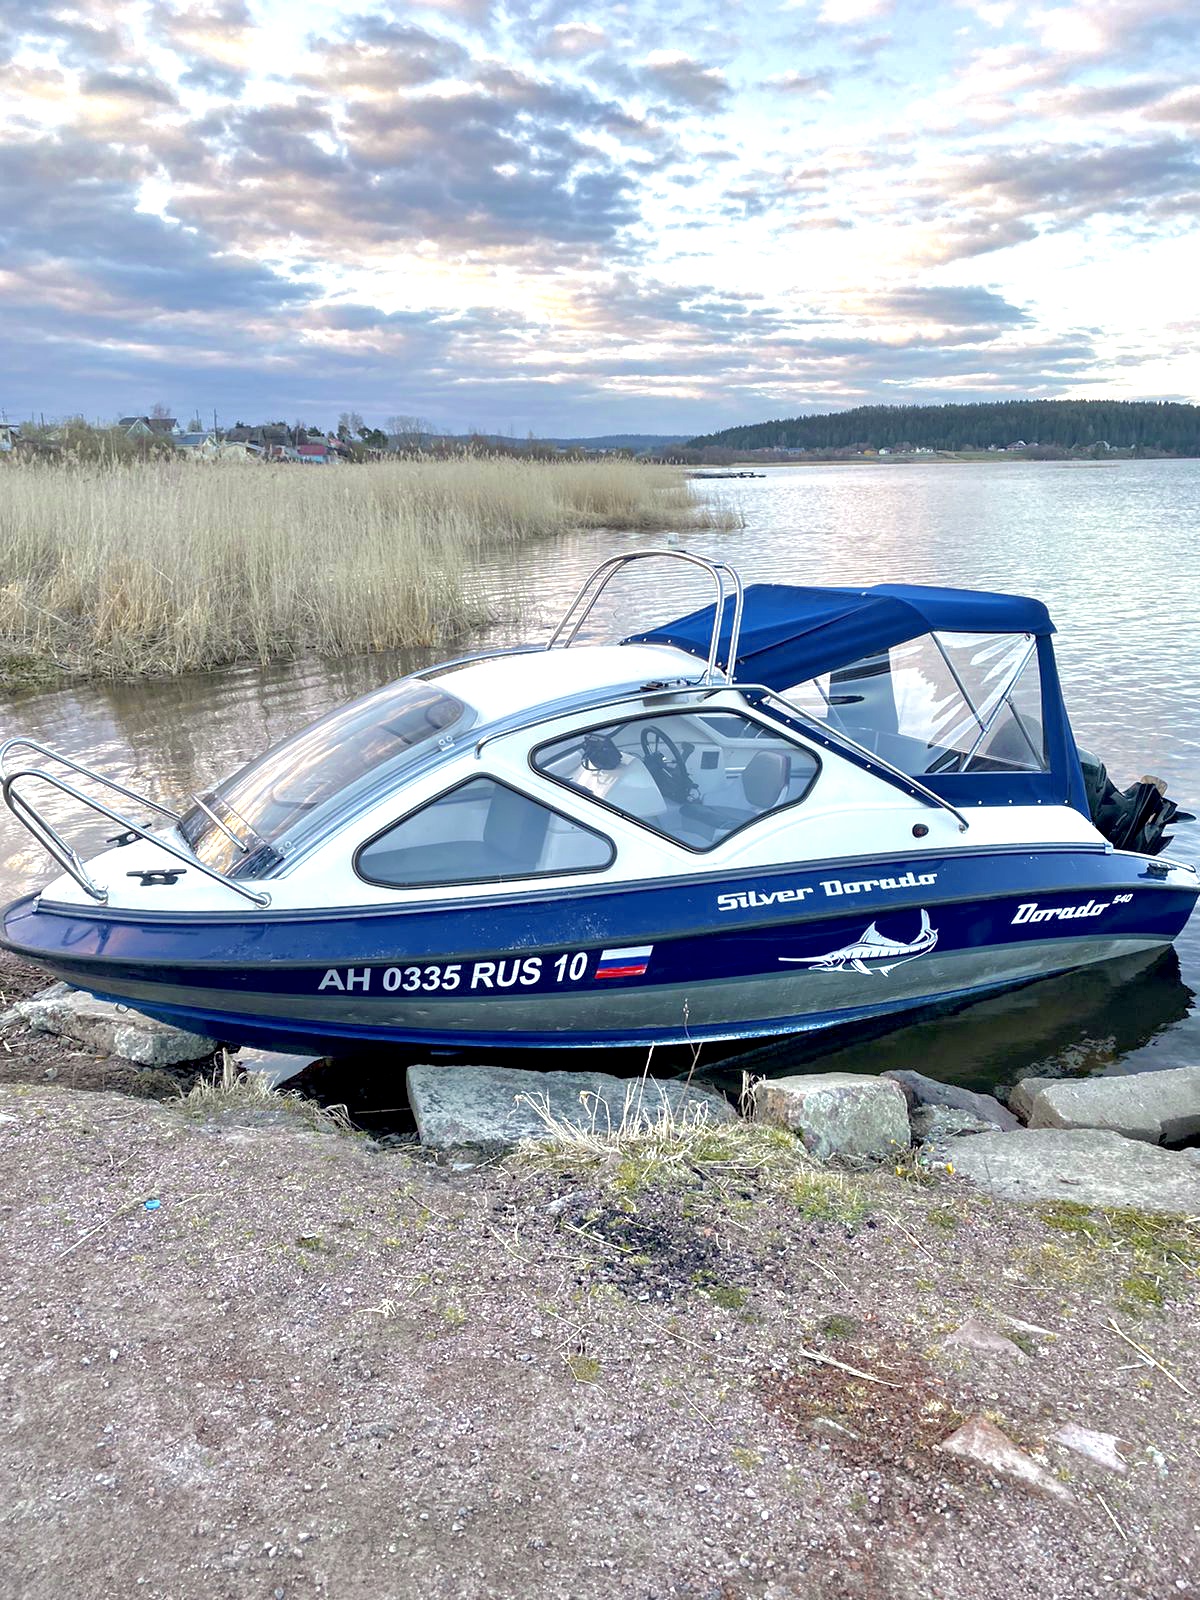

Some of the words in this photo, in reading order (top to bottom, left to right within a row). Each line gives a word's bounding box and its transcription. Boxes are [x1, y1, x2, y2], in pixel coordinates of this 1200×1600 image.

[717, 887, 813, 911] Silver
[819, 872, 938, 897] Dorado
[1010, 900, 1111, 925] Dorado
[1112, 893, 1134, 904] 540
[318, 967, 371, 991] AH
[382, 964, 462, 991] 0335
[470, 957, 542, 989] RUS
[553, 951, 589, 983] 10
